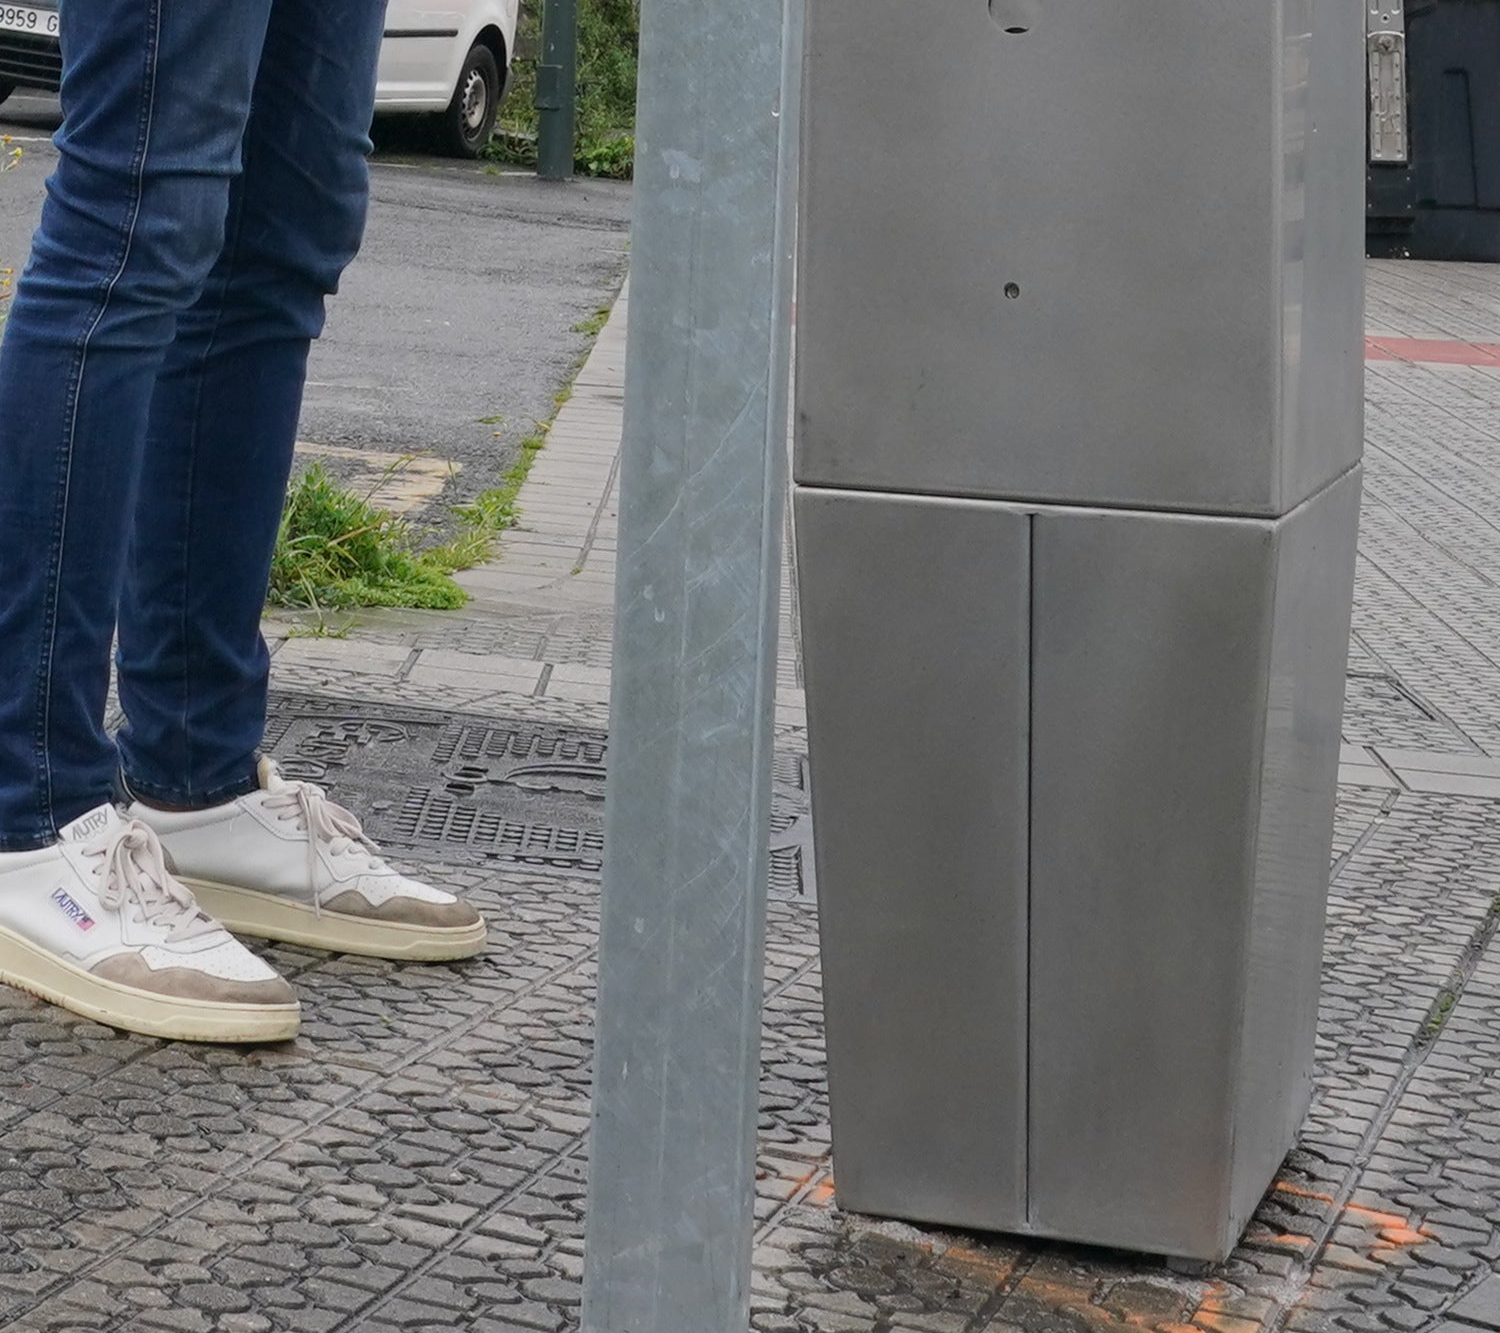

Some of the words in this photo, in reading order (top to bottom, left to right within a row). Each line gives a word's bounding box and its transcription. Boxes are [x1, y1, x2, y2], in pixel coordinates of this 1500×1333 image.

[47, 15, 58, 32] G
[71, 807, 110, 841] AUTRY
[53, 891, 83, 922] AUTRY
